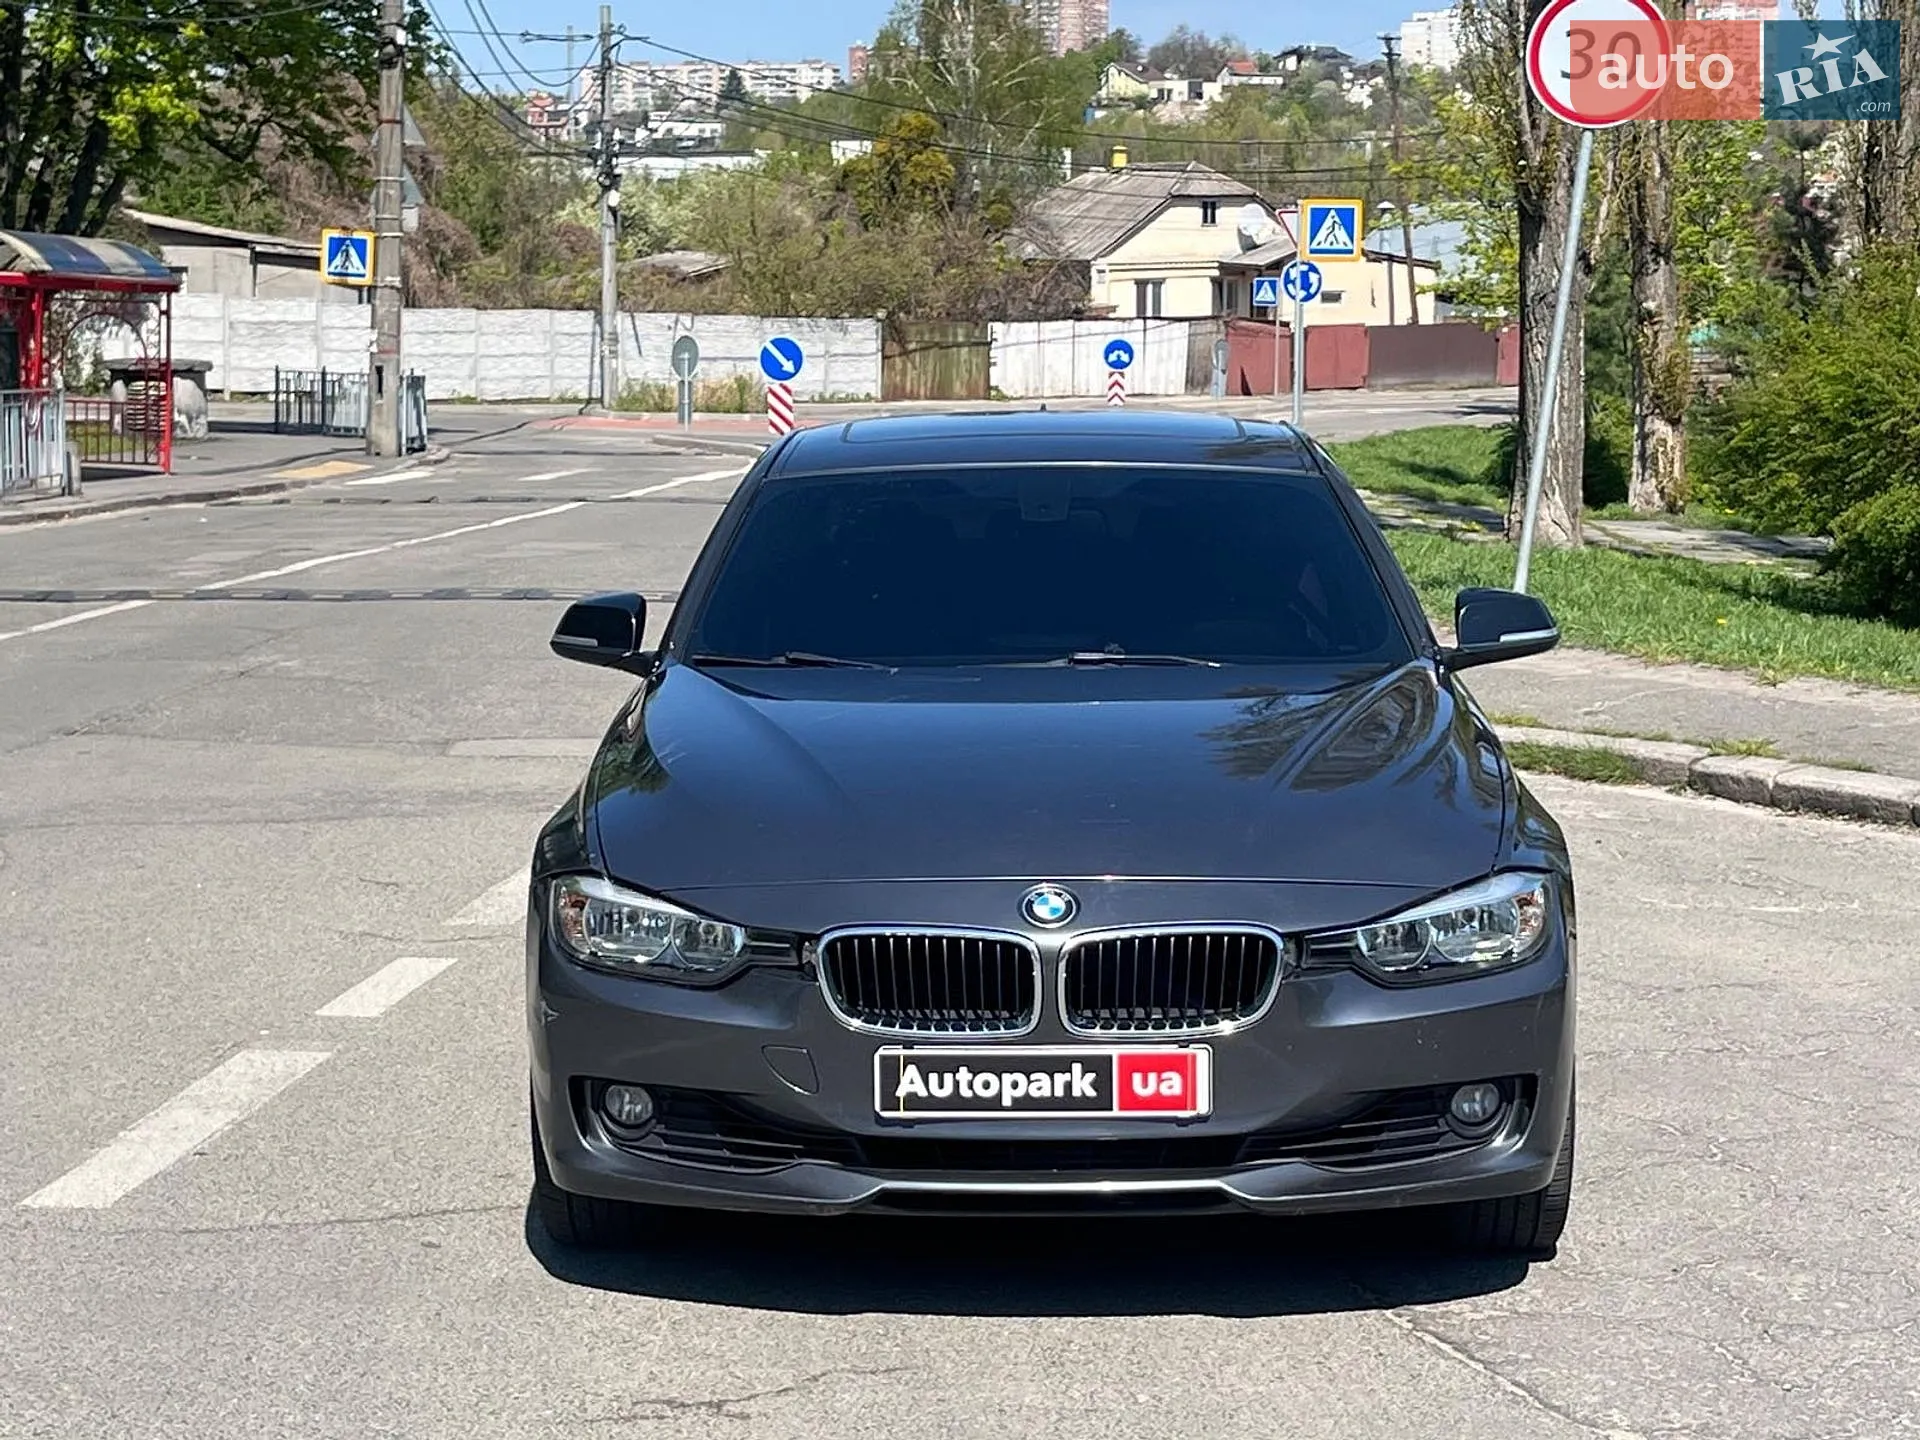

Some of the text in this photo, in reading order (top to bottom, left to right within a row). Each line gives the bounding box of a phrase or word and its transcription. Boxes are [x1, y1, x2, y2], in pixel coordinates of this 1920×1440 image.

[1560, 27, 1641, 82] 30
[895, 1063, 1183, 1107] Autopark ua
